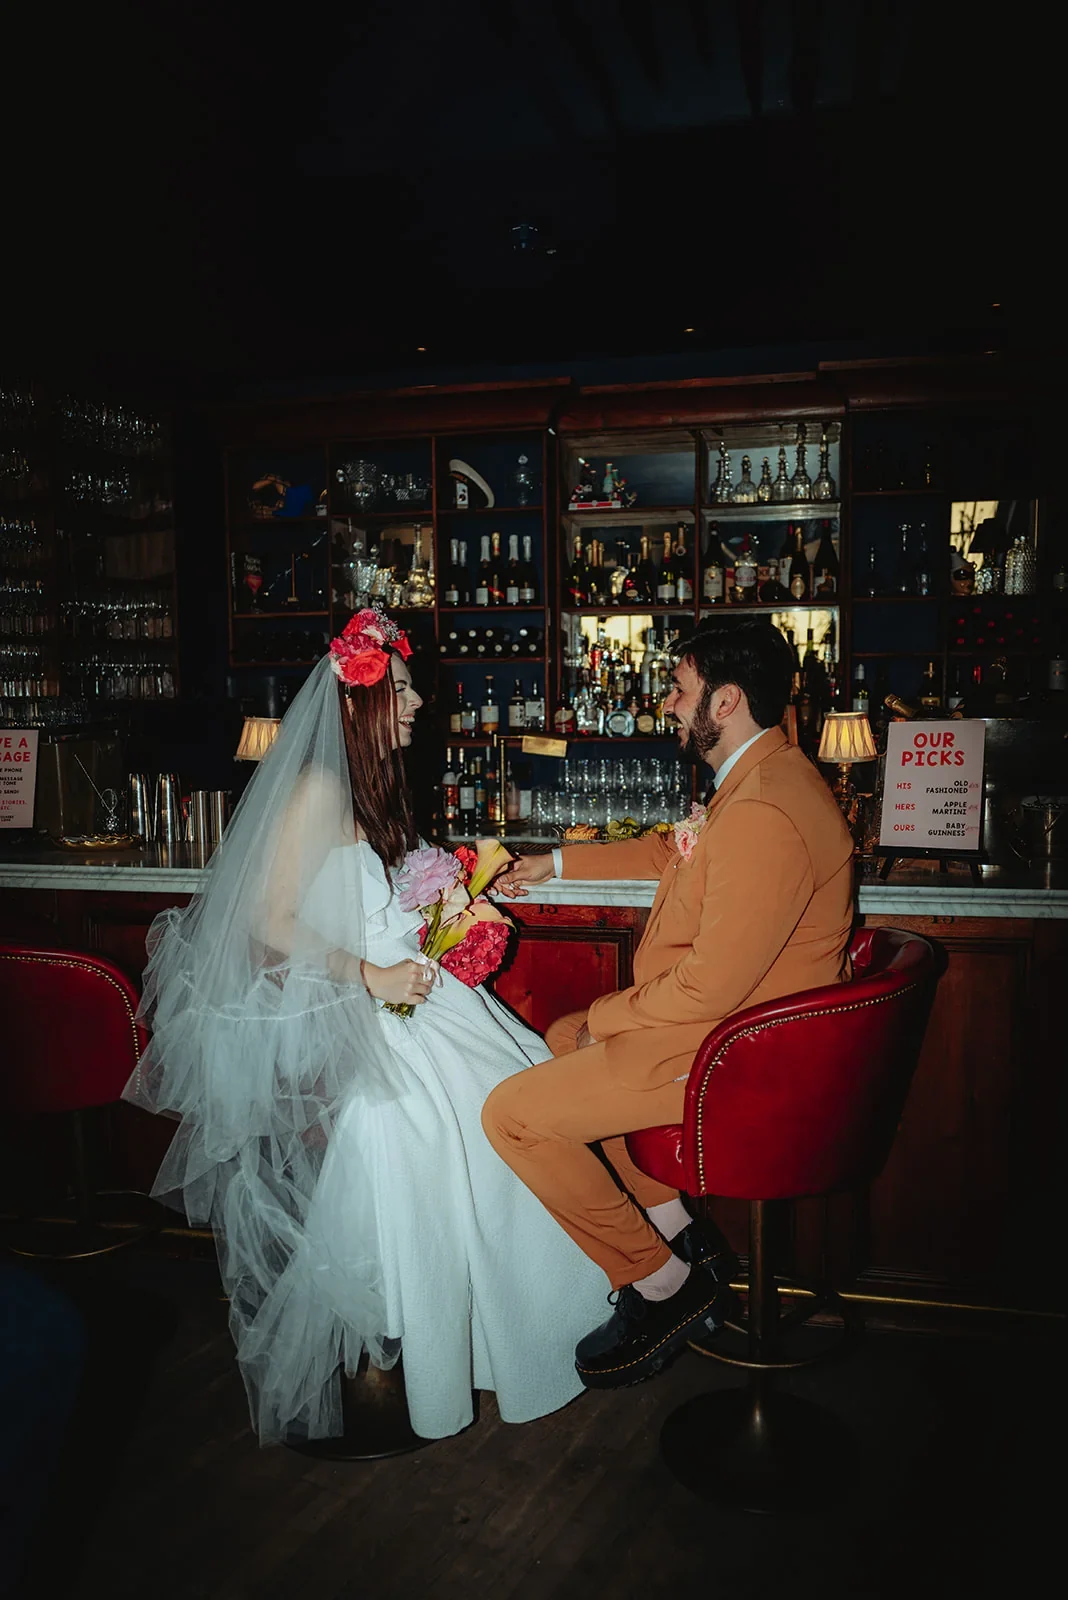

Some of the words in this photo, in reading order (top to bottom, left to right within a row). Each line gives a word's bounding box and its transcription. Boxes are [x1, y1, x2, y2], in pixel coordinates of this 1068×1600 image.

[18, 737, 28, 748] A
[913, 731, 955, 748] OUR
[0, 751, 31, 762] AGE
[901, 750, 965, 767] PICKS
[896, 782, 912, 790] HIS
[895, 803, 916, 811] HERS
[893, 824, 915, 832] OURS
